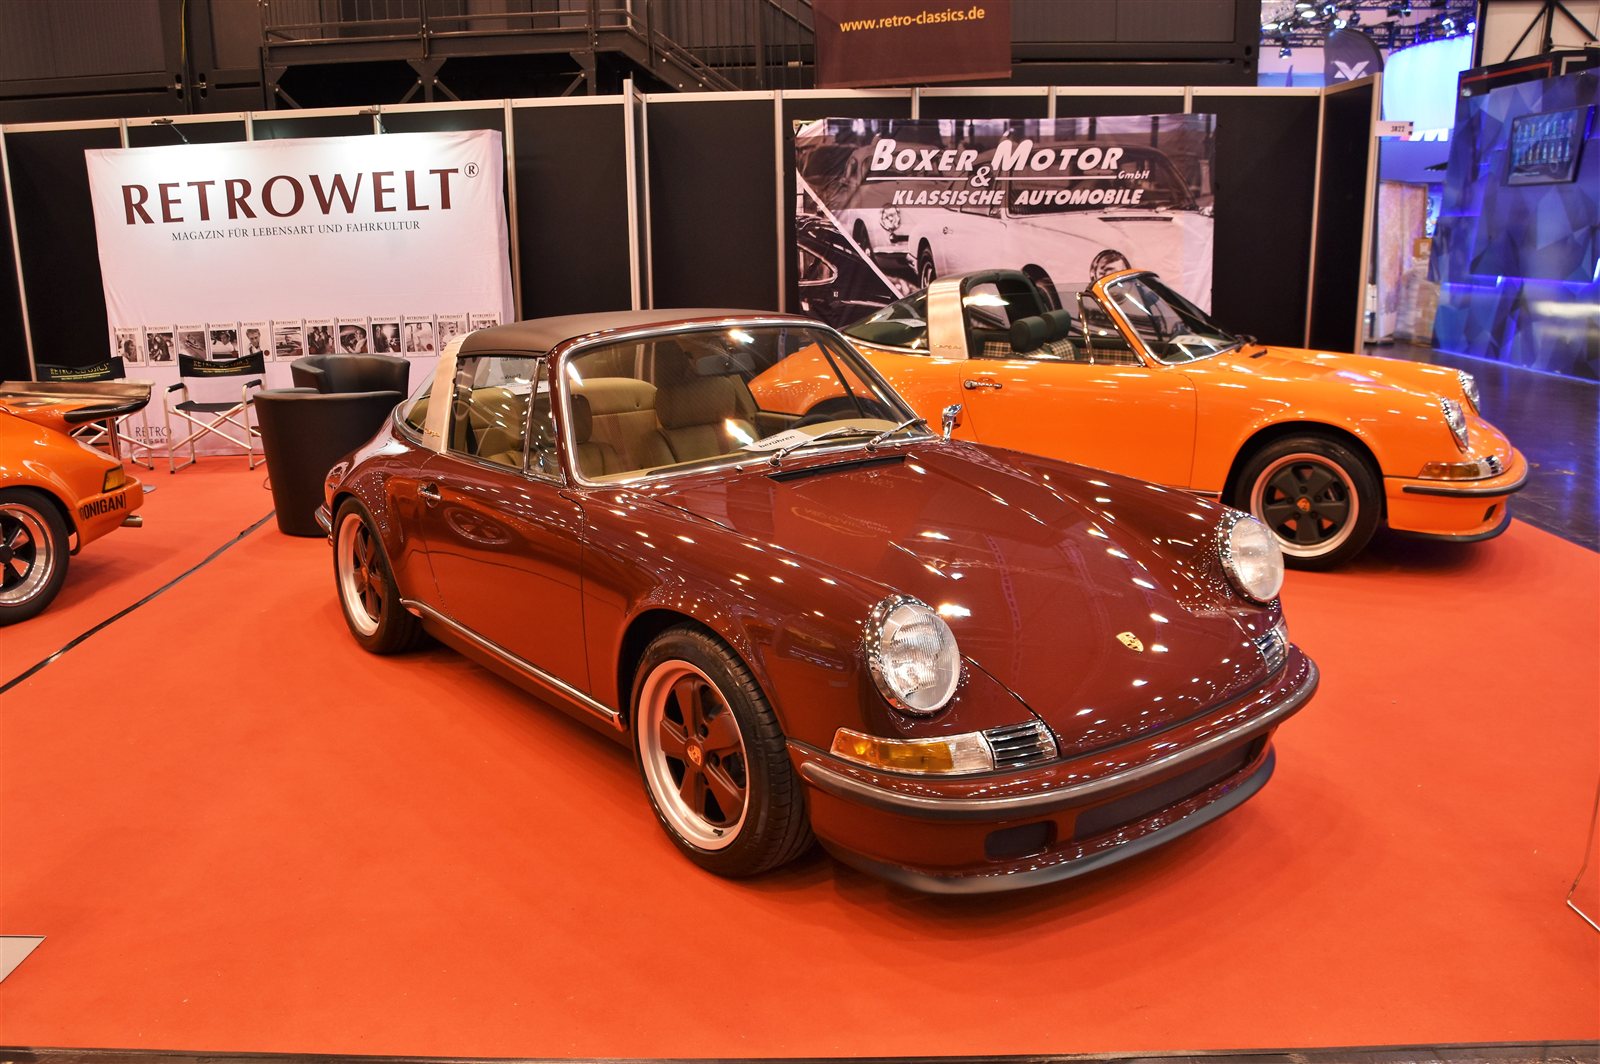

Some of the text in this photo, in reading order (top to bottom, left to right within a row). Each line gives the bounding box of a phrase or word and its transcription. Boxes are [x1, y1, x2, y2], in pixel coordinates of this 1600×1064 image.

[840, 6, 985, 32] www.retro-classics.de
[870, 138, 1150, 179] BOXER MOTOR GmbH
[970, 166, 991, 187] &
[892, 189, 1144, 205] KLASSISCHE AUTOMOBILE
[171, 220, 421, 241] MAGAZIN FÜR LEBENSART UND FAHRKULTUR
